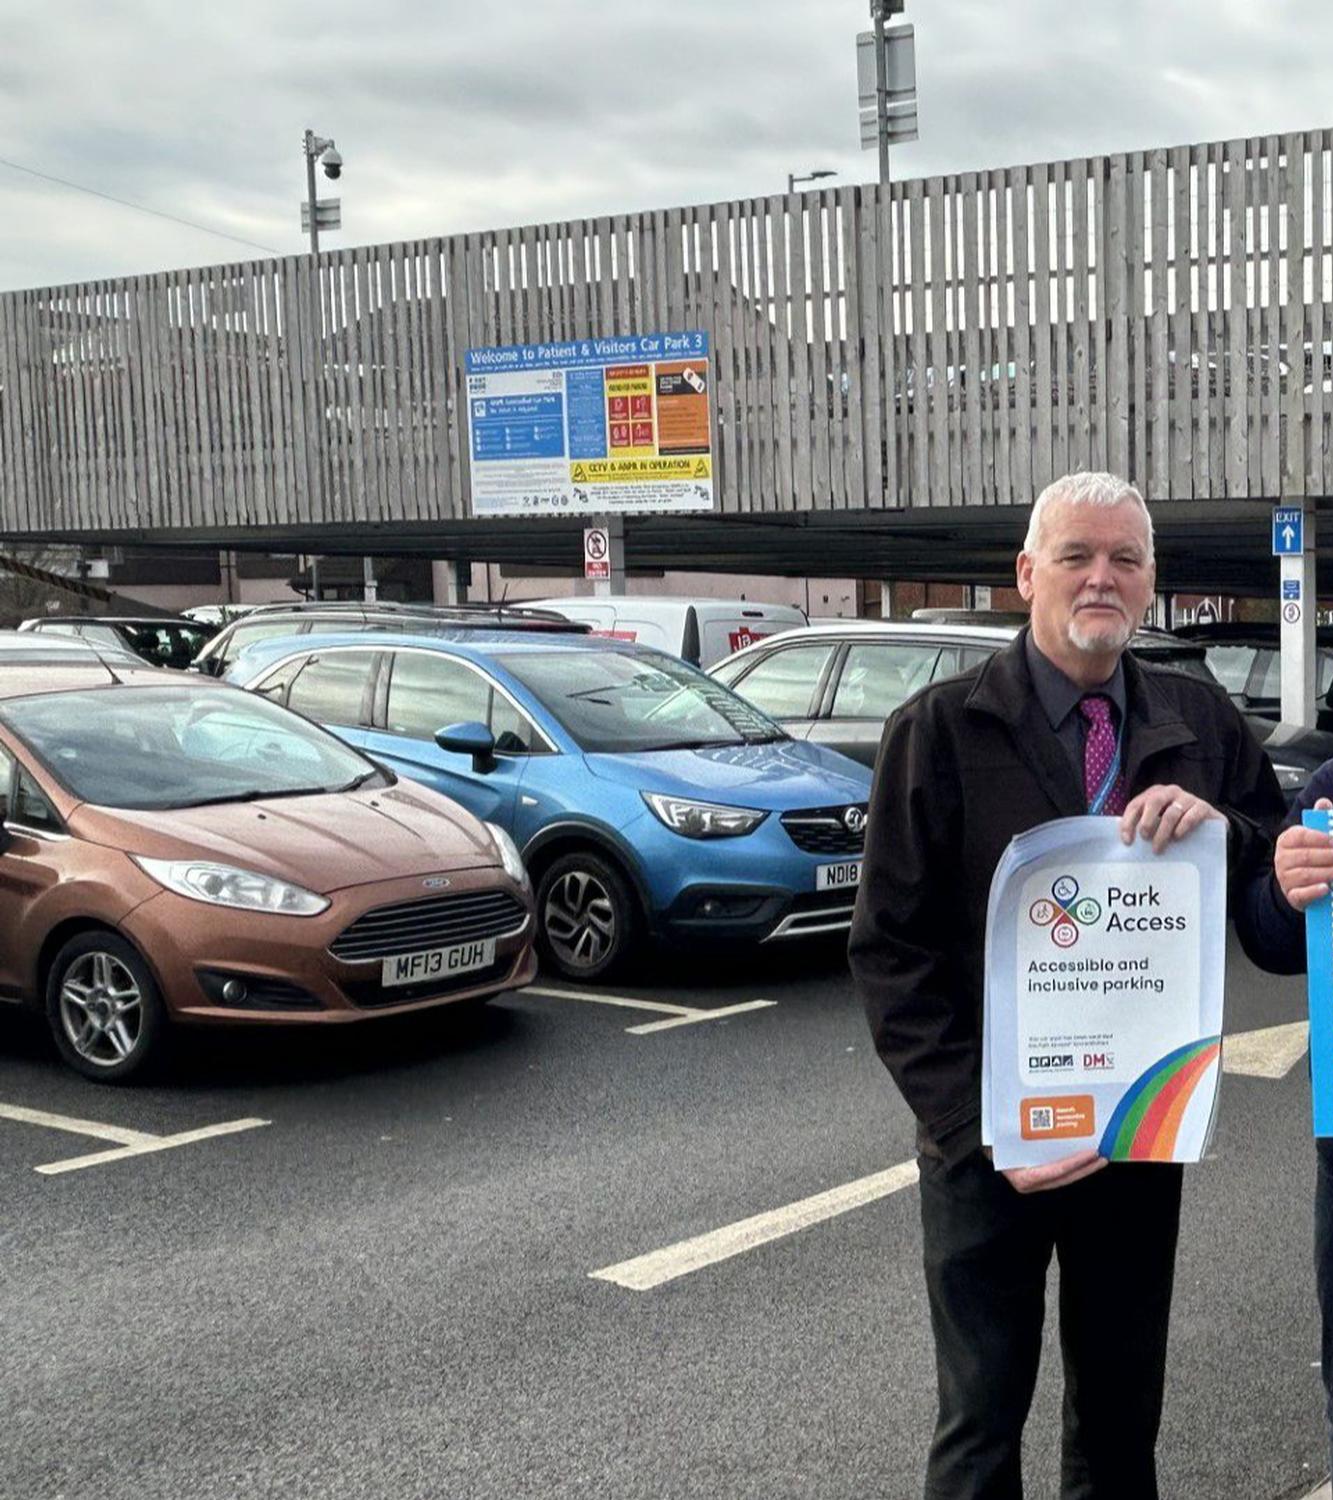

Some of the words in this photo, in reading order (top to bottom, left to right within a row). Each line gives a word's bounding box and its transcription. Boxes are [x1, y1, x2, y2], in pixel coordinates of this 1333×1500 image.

[470, 350, 518, 364] Welcome
[522, 349, 535, 360] to
[538, 344, 577, 359] Patient
[581, 343, 590, 356] &
[594, 339, 637, 354] Visitors
[640, 338, 660, 351] Car
[664, 335, 690, 350] Park
[695, 334, 702, 348] 3
[588, 462, 608, 473] CCTV
[649, 459, 690, 470] OPERATION
[1275, 511, 1300, 523] EXIT
[827, 864, 858, 885] ND18
[1108, 884, 1160, 908] Park
[1106, 912, 1187, 933] Access
[396, 952, 443, 980] MF13
[448, 942, 485, 970] GUH
[1028, 957, 1114, 973] Accessible
[1118, 957, 1149, 971] and
[1028, 977, 1099, 993] inclusive
[1103, 975, 1164, 995] parking
